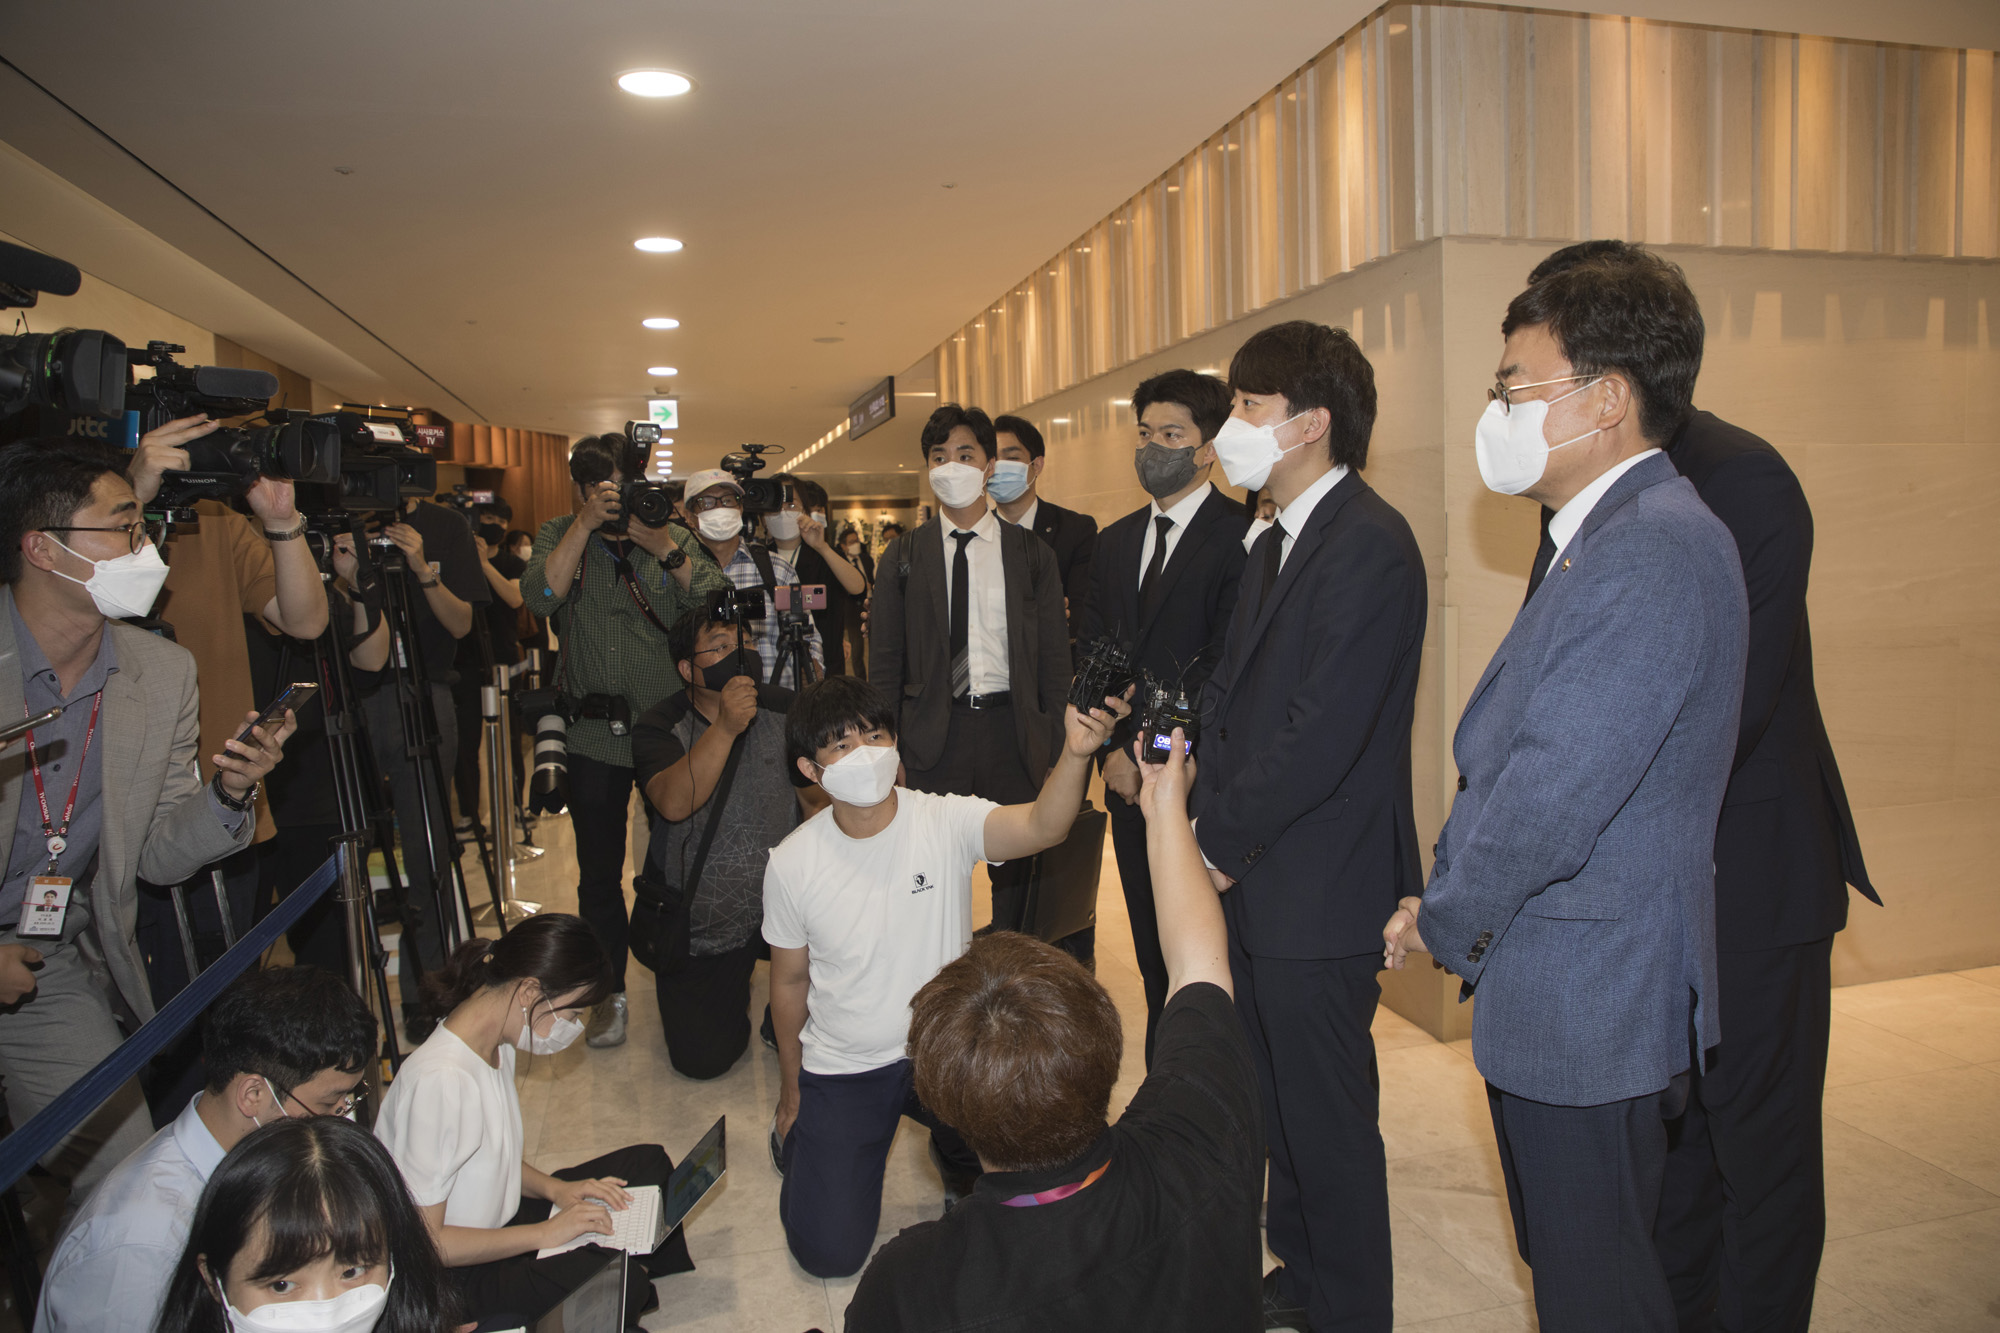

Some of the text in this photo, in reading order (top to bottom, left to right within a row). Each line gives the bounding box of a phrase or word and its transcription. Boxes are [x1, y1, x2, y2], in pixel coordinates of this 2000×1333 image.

[417, 428, 445, 436] 시사포커스
[426, 437, 436, 445] TV
[1157, 736, 1171, 745] OB
